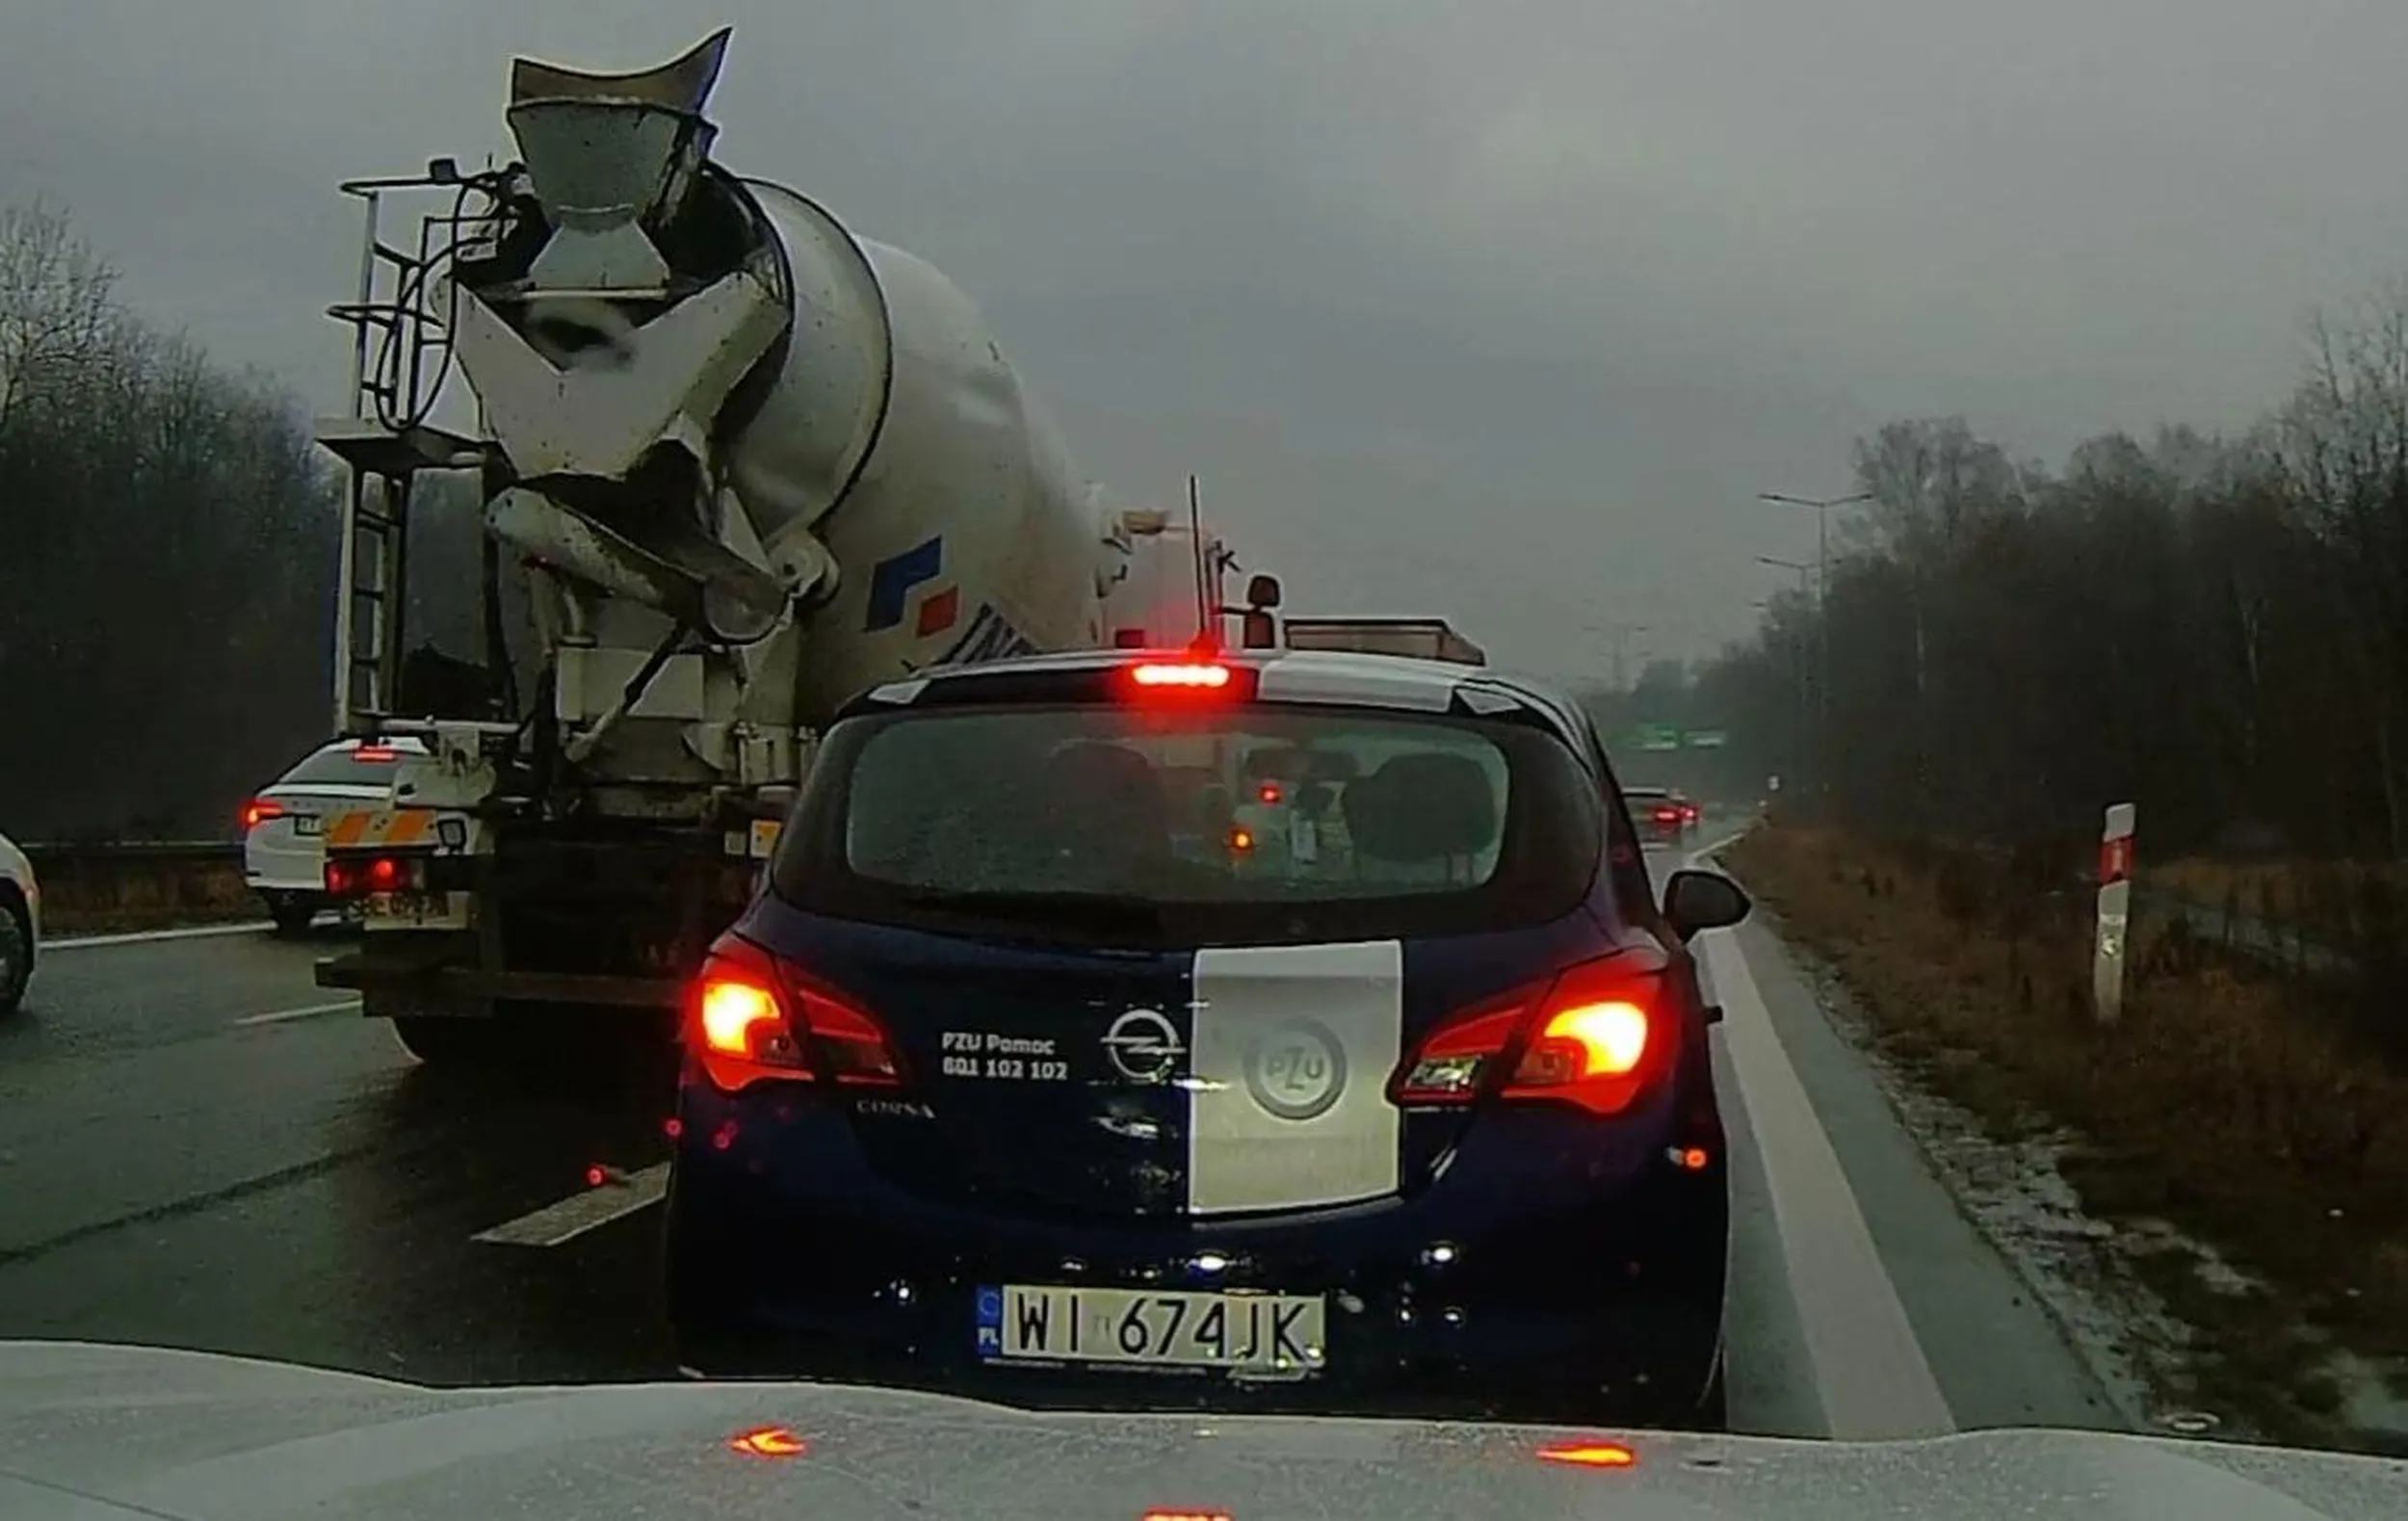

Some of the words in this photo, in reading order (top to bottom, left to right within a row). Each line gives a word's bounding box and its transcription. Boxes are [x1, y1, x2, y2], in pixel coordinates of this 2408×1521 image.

[942, 1032, 982, 1051] PZU
[986, 1034, 1056, 1055] Pomoc
[985, 1059, 1023, 1078] 102
[1031, 1061, 1067, 1080] 102
[1266, 1046, 1324, 1090] PZU
[1017, 1293, 1080, 1352] WI
[1118, 1298, 1307, 1362] 674JK
